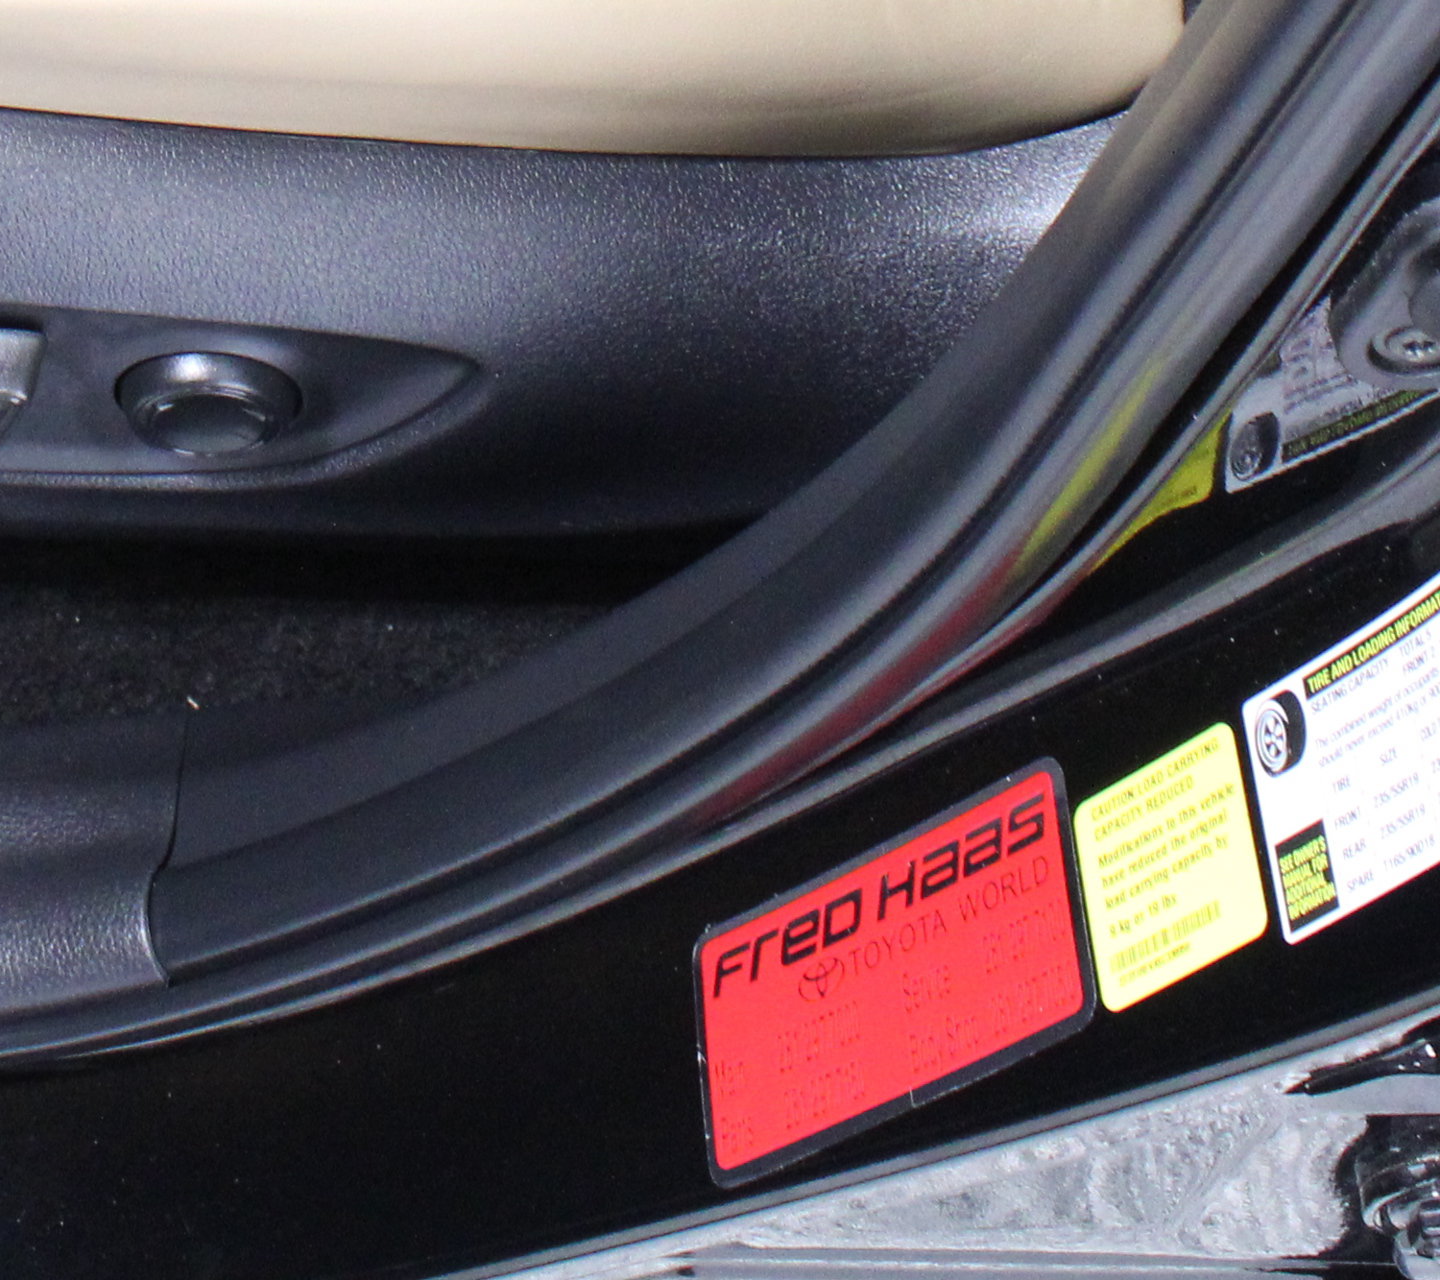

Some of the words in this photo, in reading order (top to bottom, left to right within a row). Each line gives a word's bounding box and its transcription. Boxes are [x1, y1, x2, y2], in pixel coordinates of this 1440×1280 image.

[1307, 668, 1330, 692] TIRE
[1330, 654, 1353, 679] AND
[1352, 626, 1396, 665] LOADING
[1310, 683, 1347, 712] SEATING
[1347, 657, 1388, 691] CAPACITY
[1398, 633, 1424, 656] TOTAL
[1401, 649, 1428, 673] FRONT
[1091, 787, 1134, 820] CAUTION
[1136, 769, 1163, 795] LOAD
[1166, 737, 1218, 777] CARRYING
[1331, 774, 1351, 792] TIRE
[1378, 745, 1398, 766] SIZE
[1094, 805, 1142, 841] CAPACITY
[1145, 774, 1193, 811] REDUCED
[1097, 824, 1164, 868] Modifications
[1165, 816, 1176, 830] to
[1177, 805, 1197, 823] this
[1199, 782, 1234, 810] vehicle
[1333, 805, 1360, 828] FRONT
[1100, 867, 1125, 889] have
[1127, 842, 1168, 874] reduced
[1169, 833, 1187, 850] the
[1188, 807, 1227, 840] original
[1104, 888, 1127, 910] load
[1128, 866, 1169, 898] carrying
[1171, 841, 1212, 874] capacity
[1214, 833, 1229, 850] by
[1278, 853, 1294, 874] SEE
[1310, 852, 1328, 874] FOR
[1341, 837, 1366, 860] REAR
[1346, 868, 1374, 893] SPARE
[848, 909, 947, 974] TOYOTA
[959, 855, 1048, 921] WORLD
[1117, 918, 1131, 934] kg
[1133, 910, 1145, 925] or
[1160, 892, 1177, 910] lbs
[714, 1060, 743, 1095] Main
[902, 964, 950, 1013] Service
[720, 1116, 753, 1154] Parts
[908, 1033, 942, 1074] Body
[945, 1015, 979, 1059] Shop
